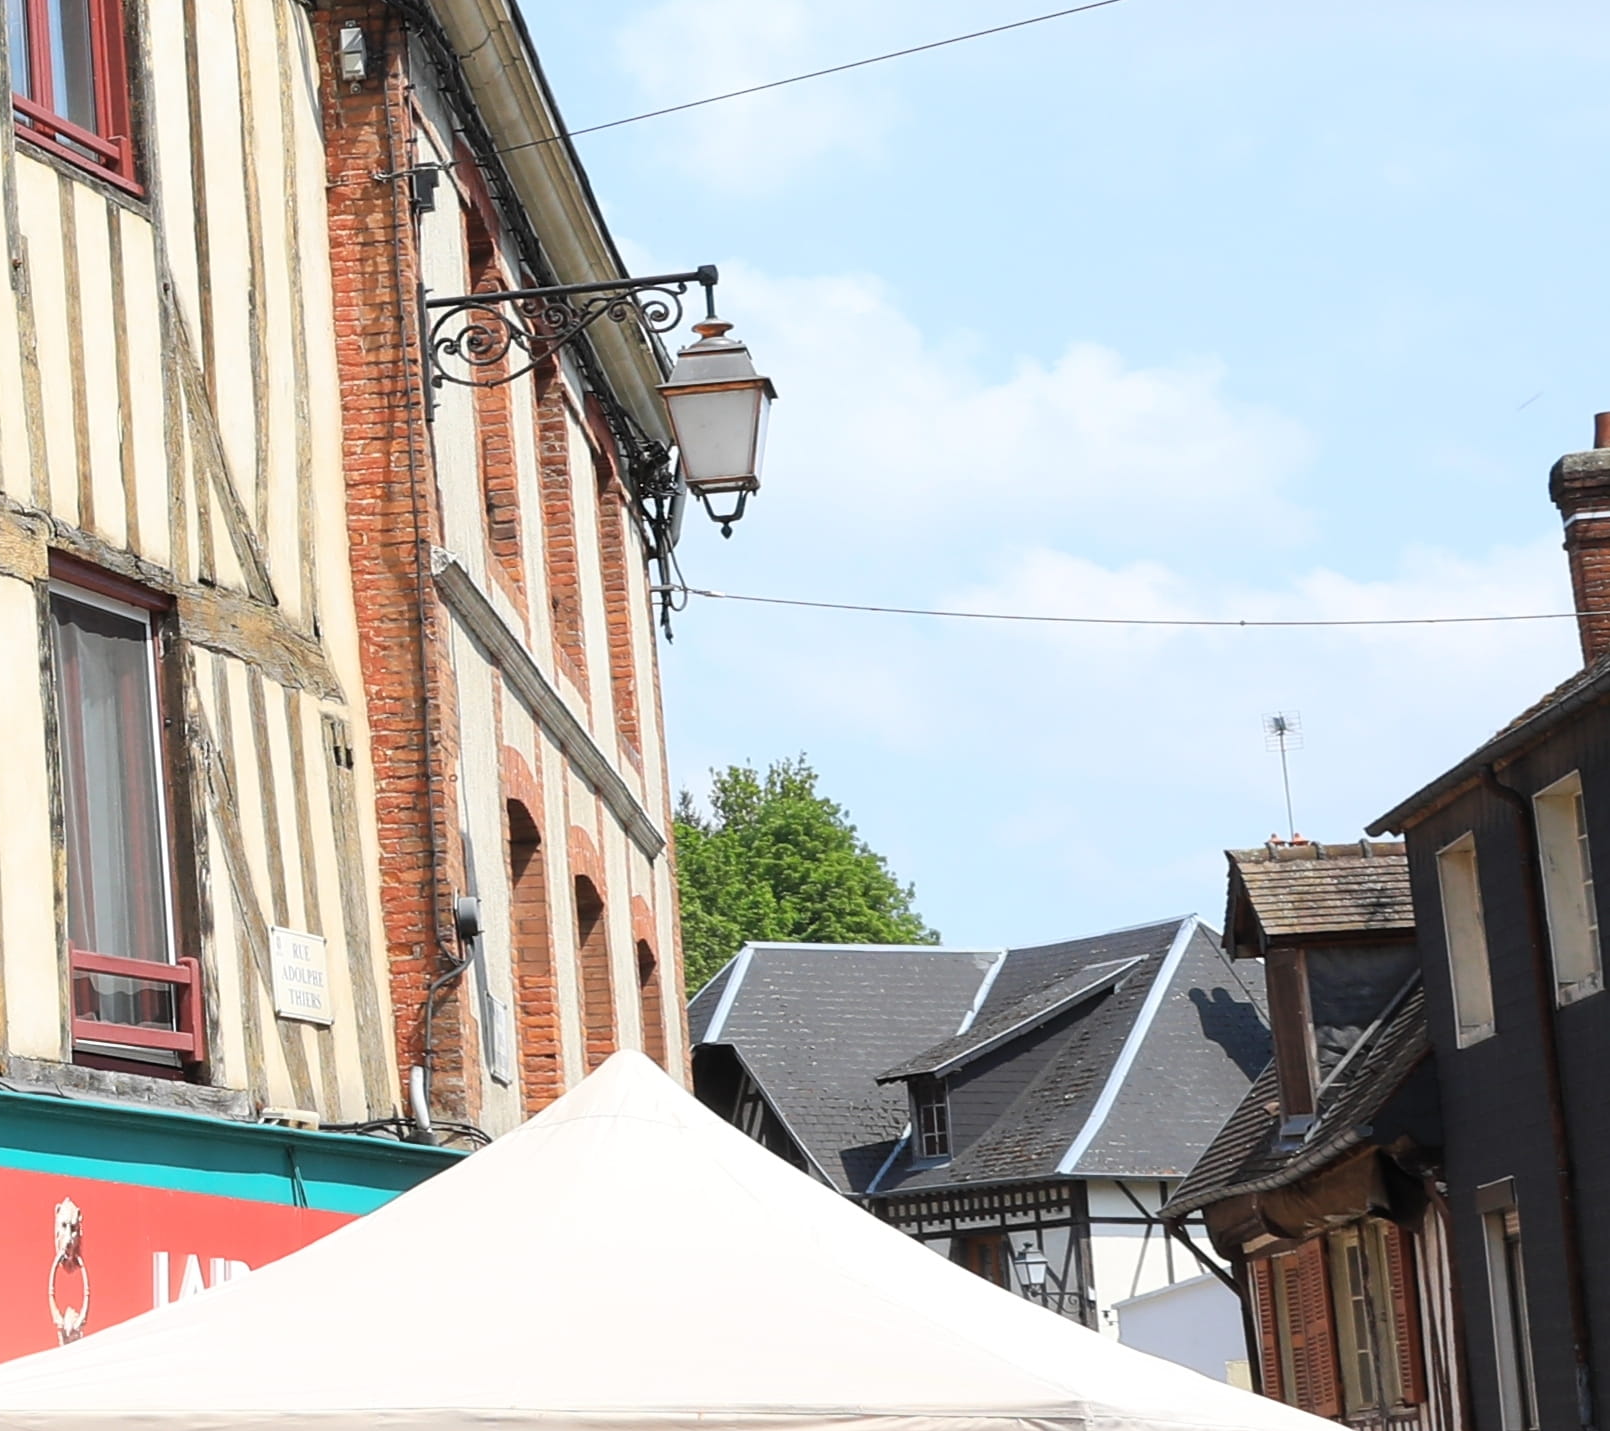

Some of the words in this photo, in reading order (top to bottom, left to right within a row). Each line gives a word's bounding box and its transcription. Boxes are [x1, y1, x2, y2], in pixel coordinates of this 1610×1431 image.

[292, 943, 311, 962] RUE
[282, 964, 324, 988] ADOLPHE
[288, 988, 321, 1010] THIERS
